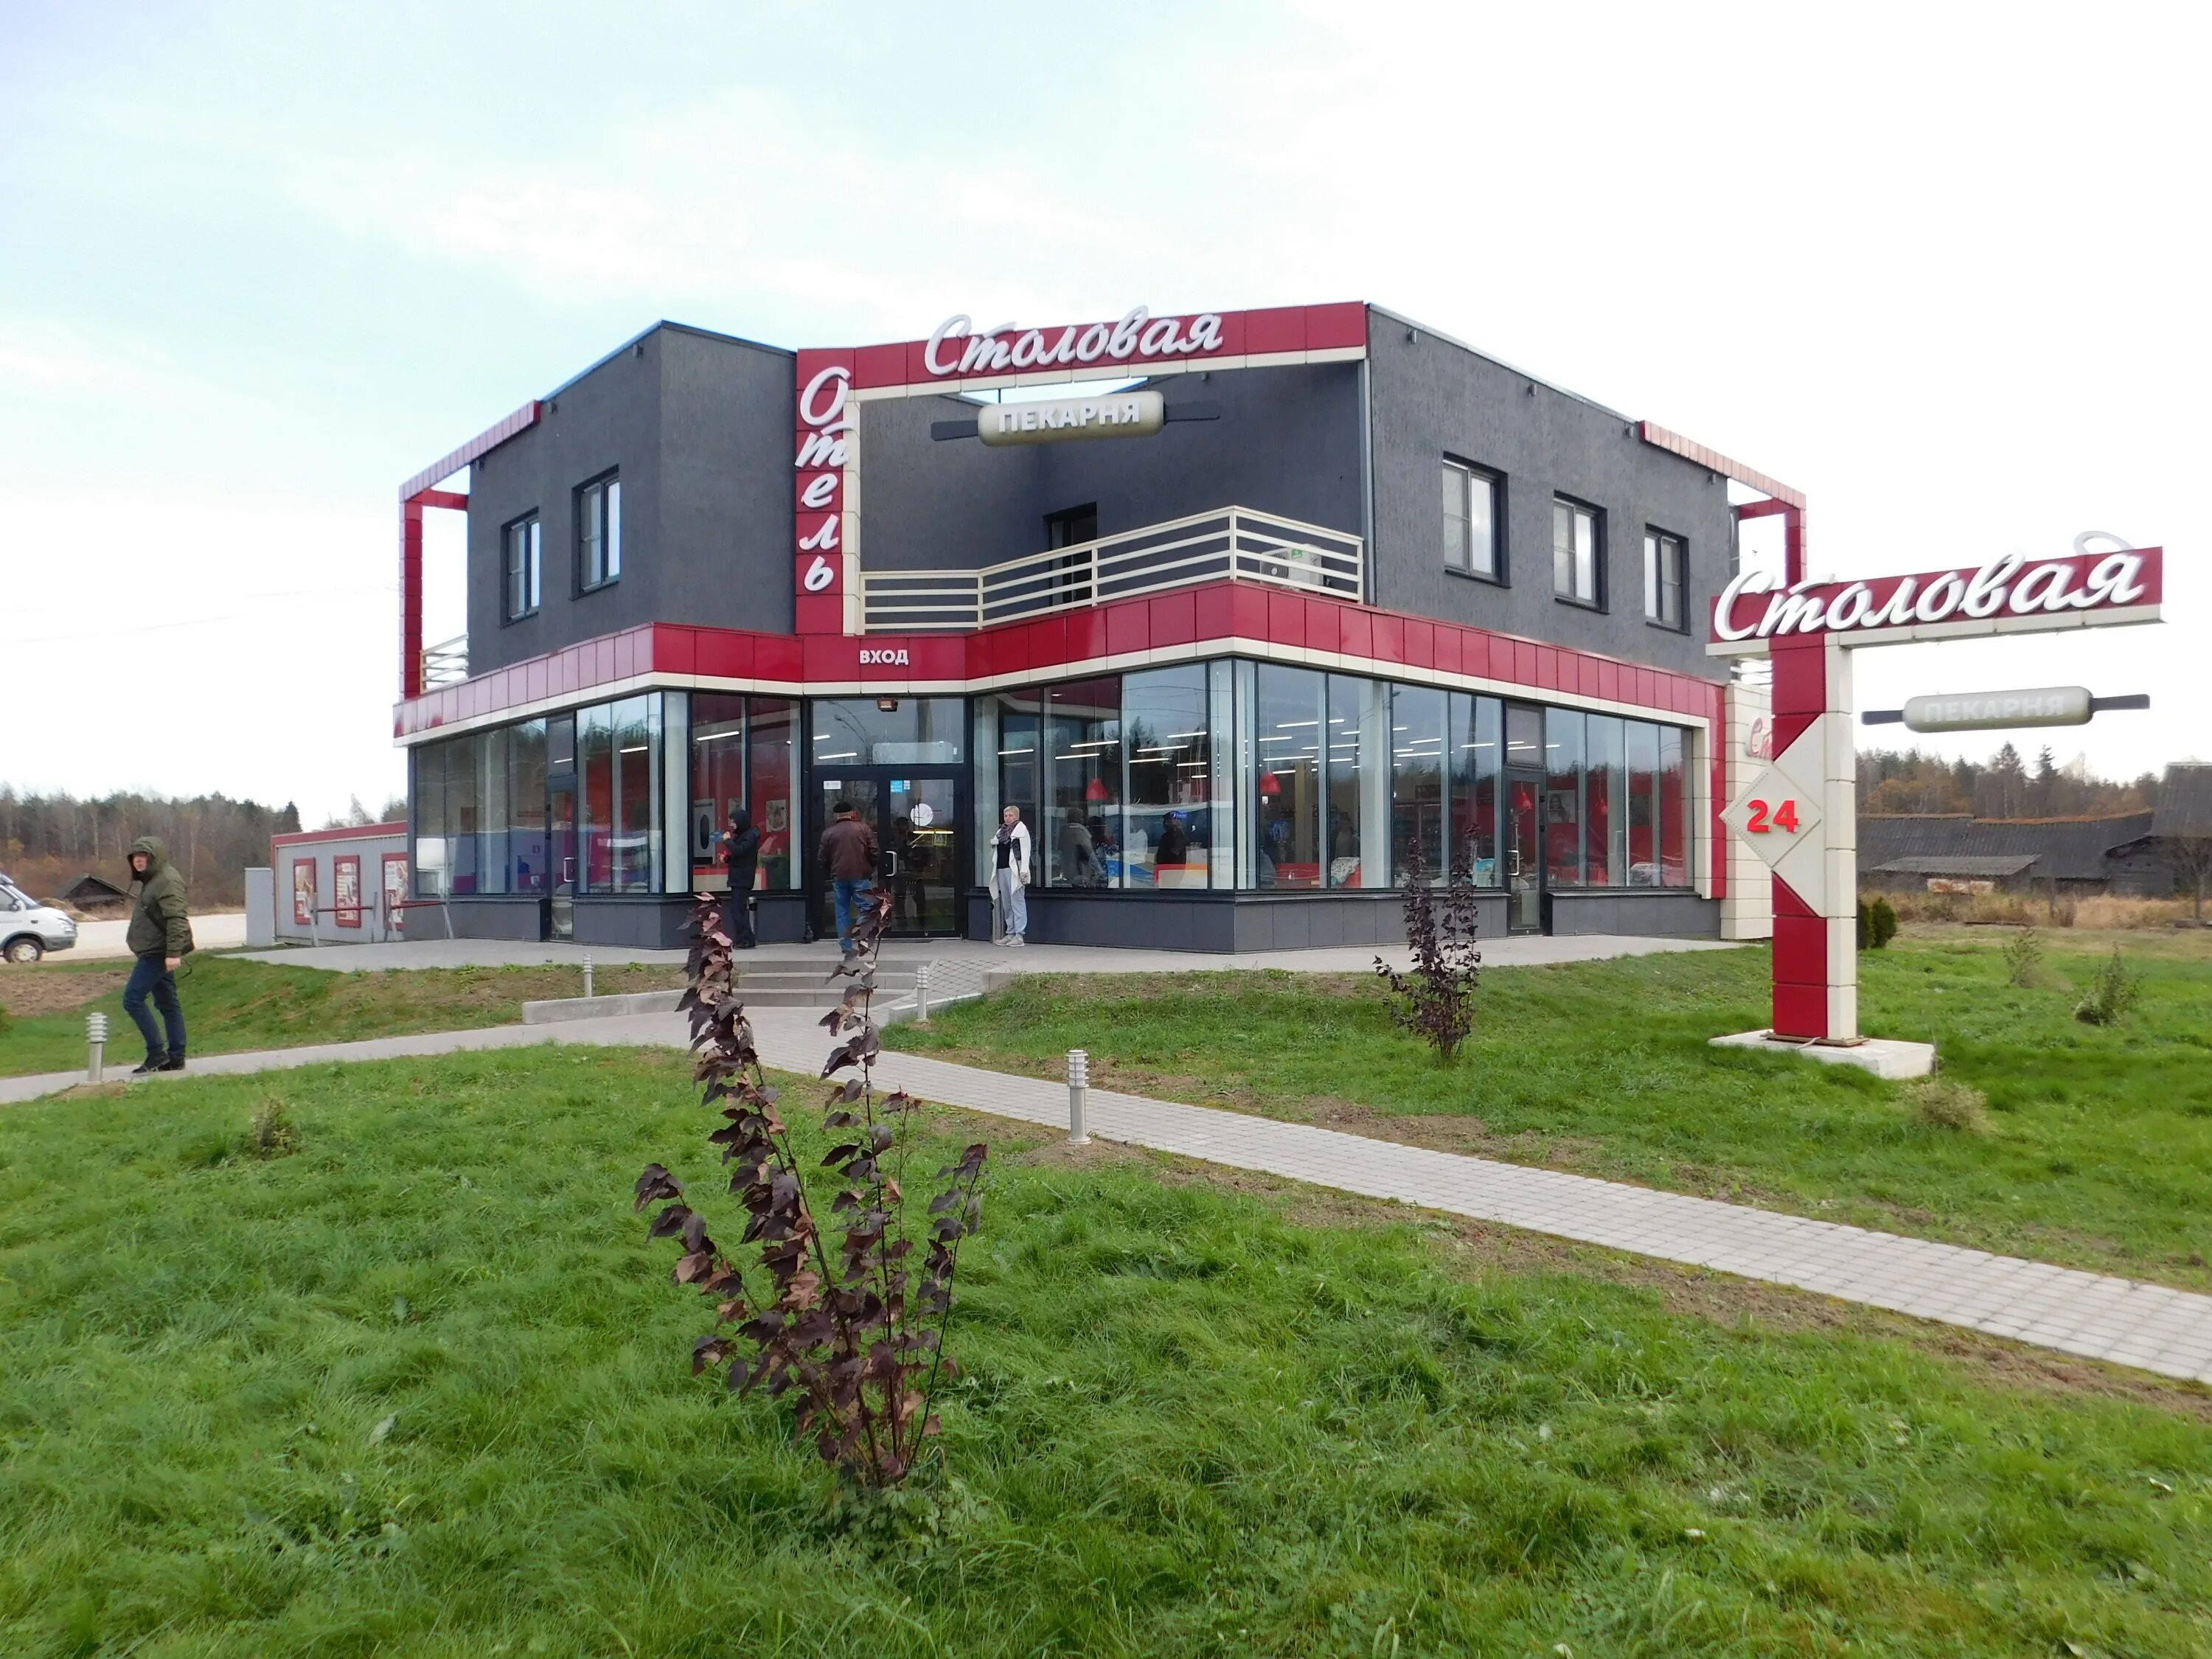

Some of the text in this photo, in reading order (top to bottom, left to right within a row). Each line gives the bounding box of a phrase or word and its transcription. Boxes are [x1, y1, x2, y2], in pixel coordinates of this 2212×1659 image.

[925, 305, 1223, 376] Столовая
[998, 401, 1140, 433] ПЕКАРНЯ
[795, 366, 855, 591] Отель
[1714, 547, 2146, 641] Столовая
[860, 649, 909, 665] ВХОД
[1924, 695, 2065, 723] ПЕКАРНЯ
[1746, 799, 1799, 834] 24
